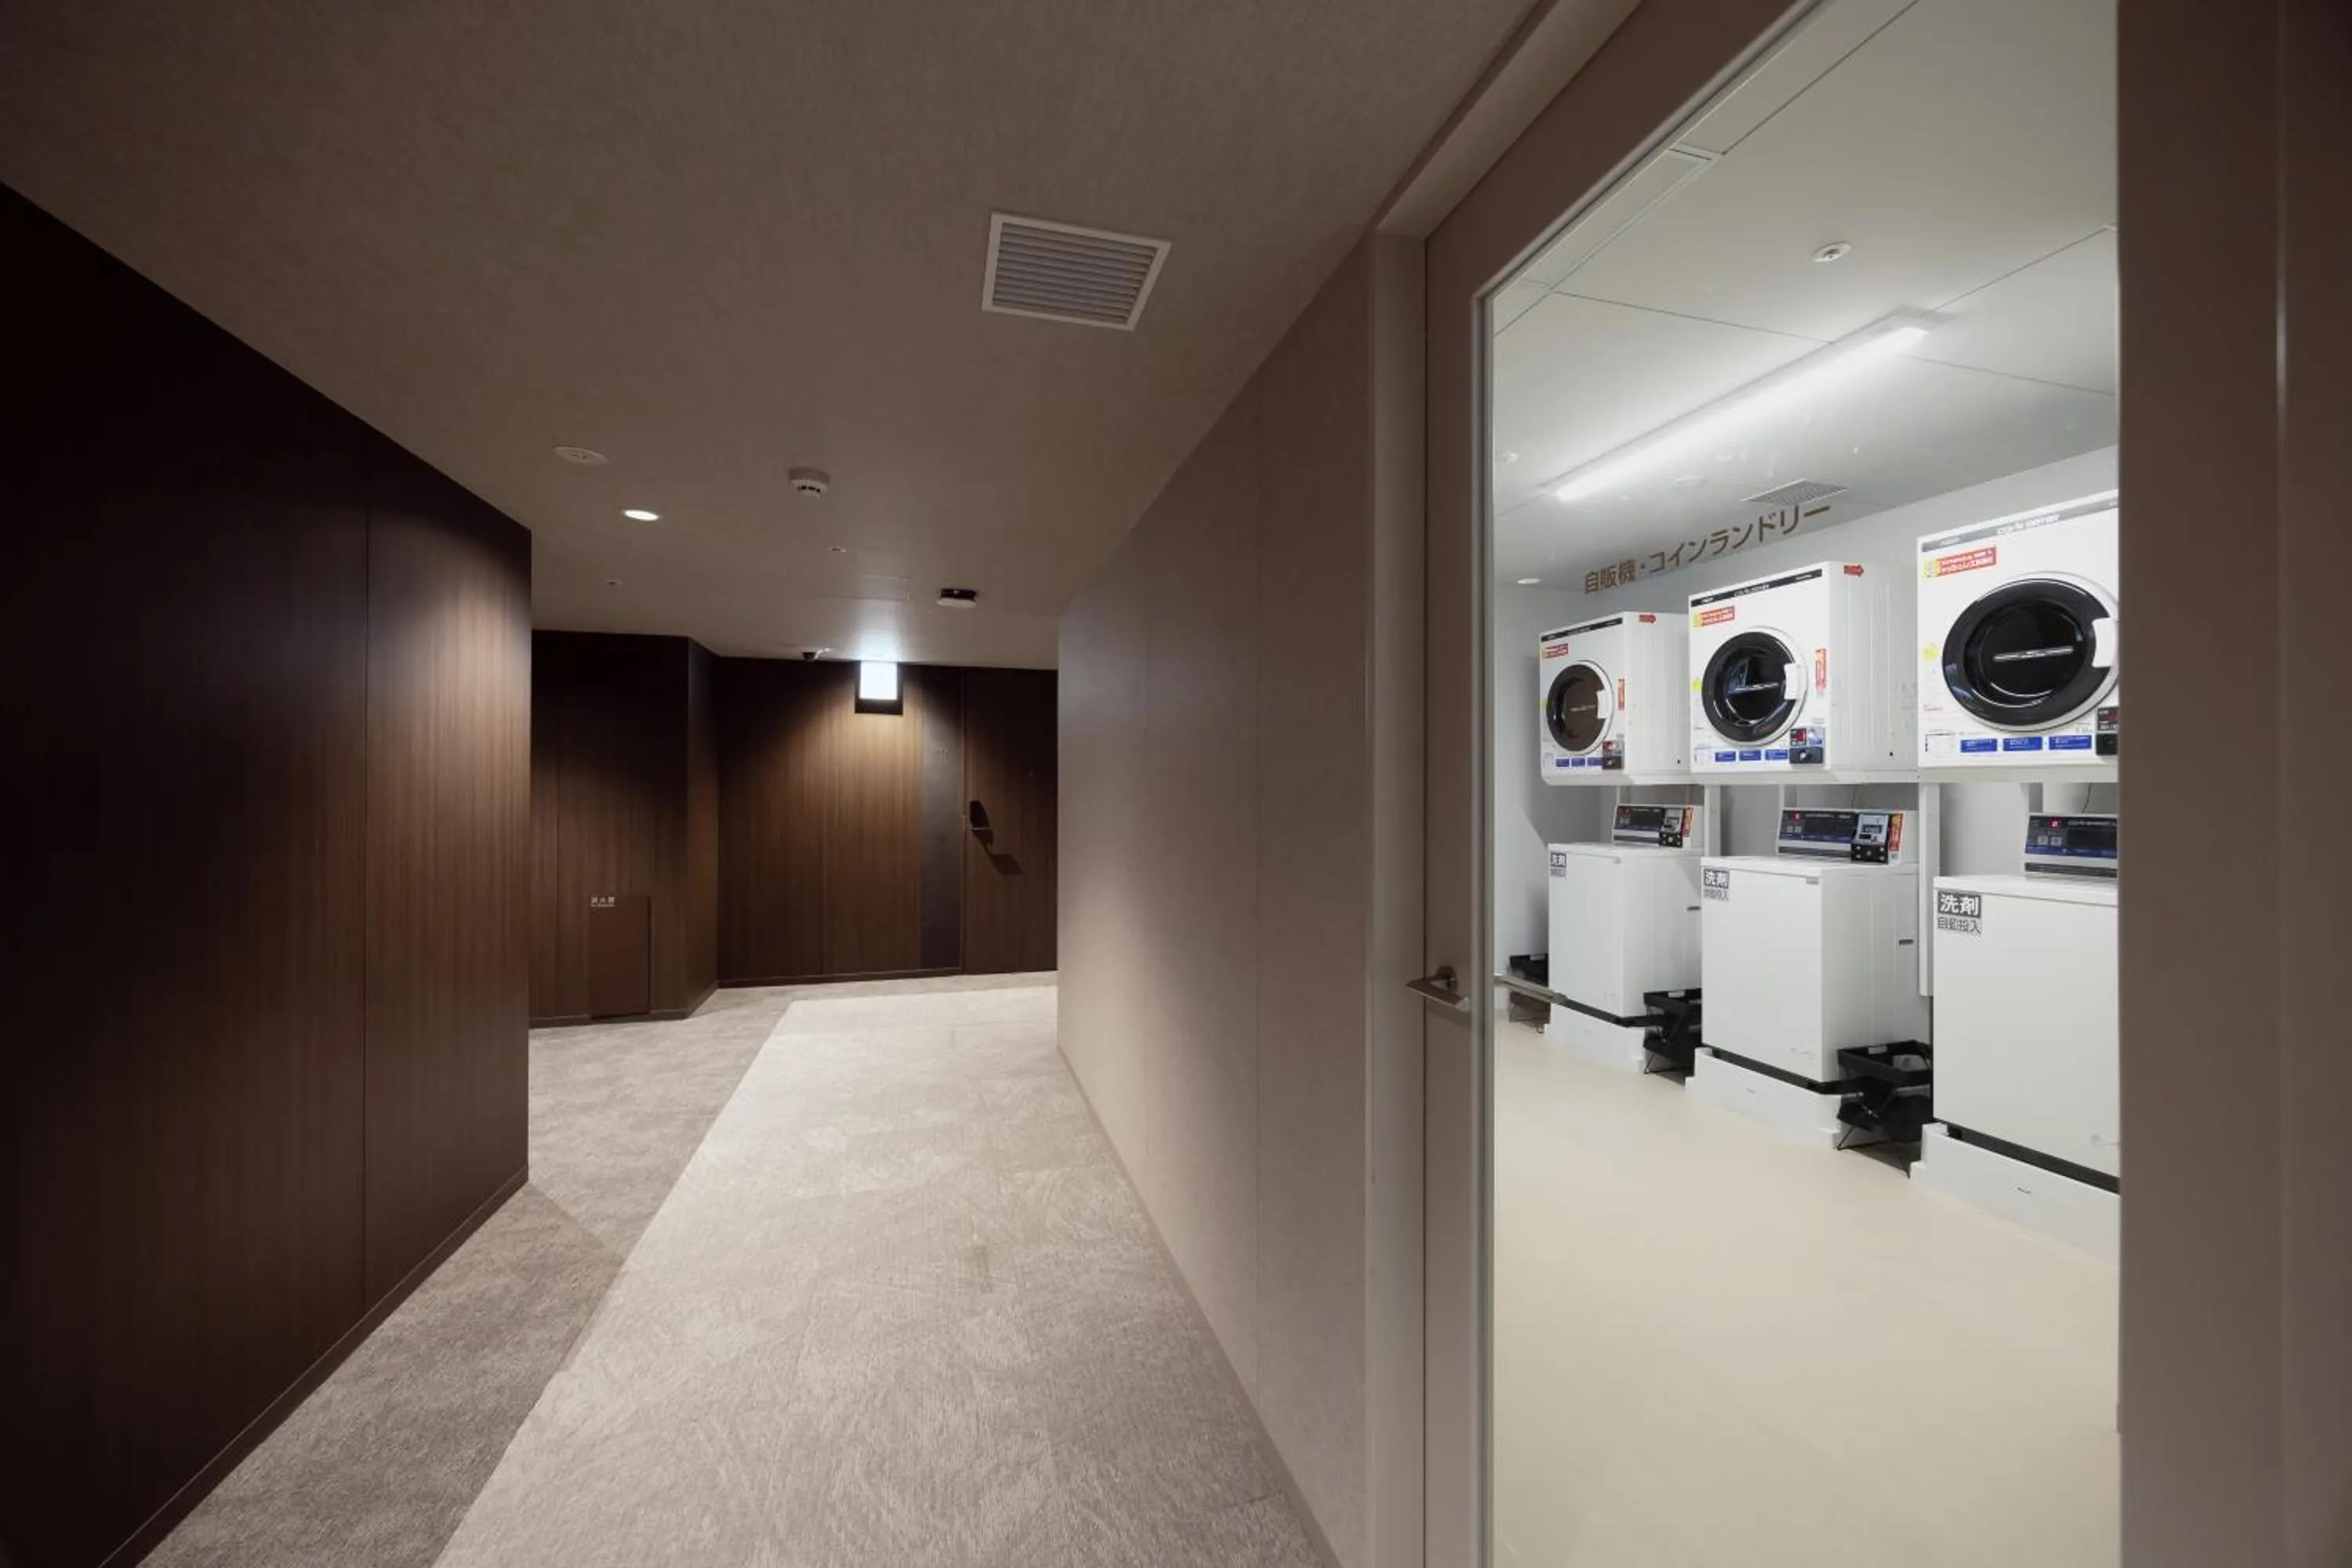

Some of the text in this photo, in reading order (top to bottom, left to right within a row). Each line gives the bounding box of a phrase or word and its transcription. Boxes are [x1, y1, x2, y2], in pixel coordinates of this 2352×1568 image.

[1584, 506, 1831, 594] 自販機・コインランドリー
[1940, 893, 1980, 916] 洗剤
